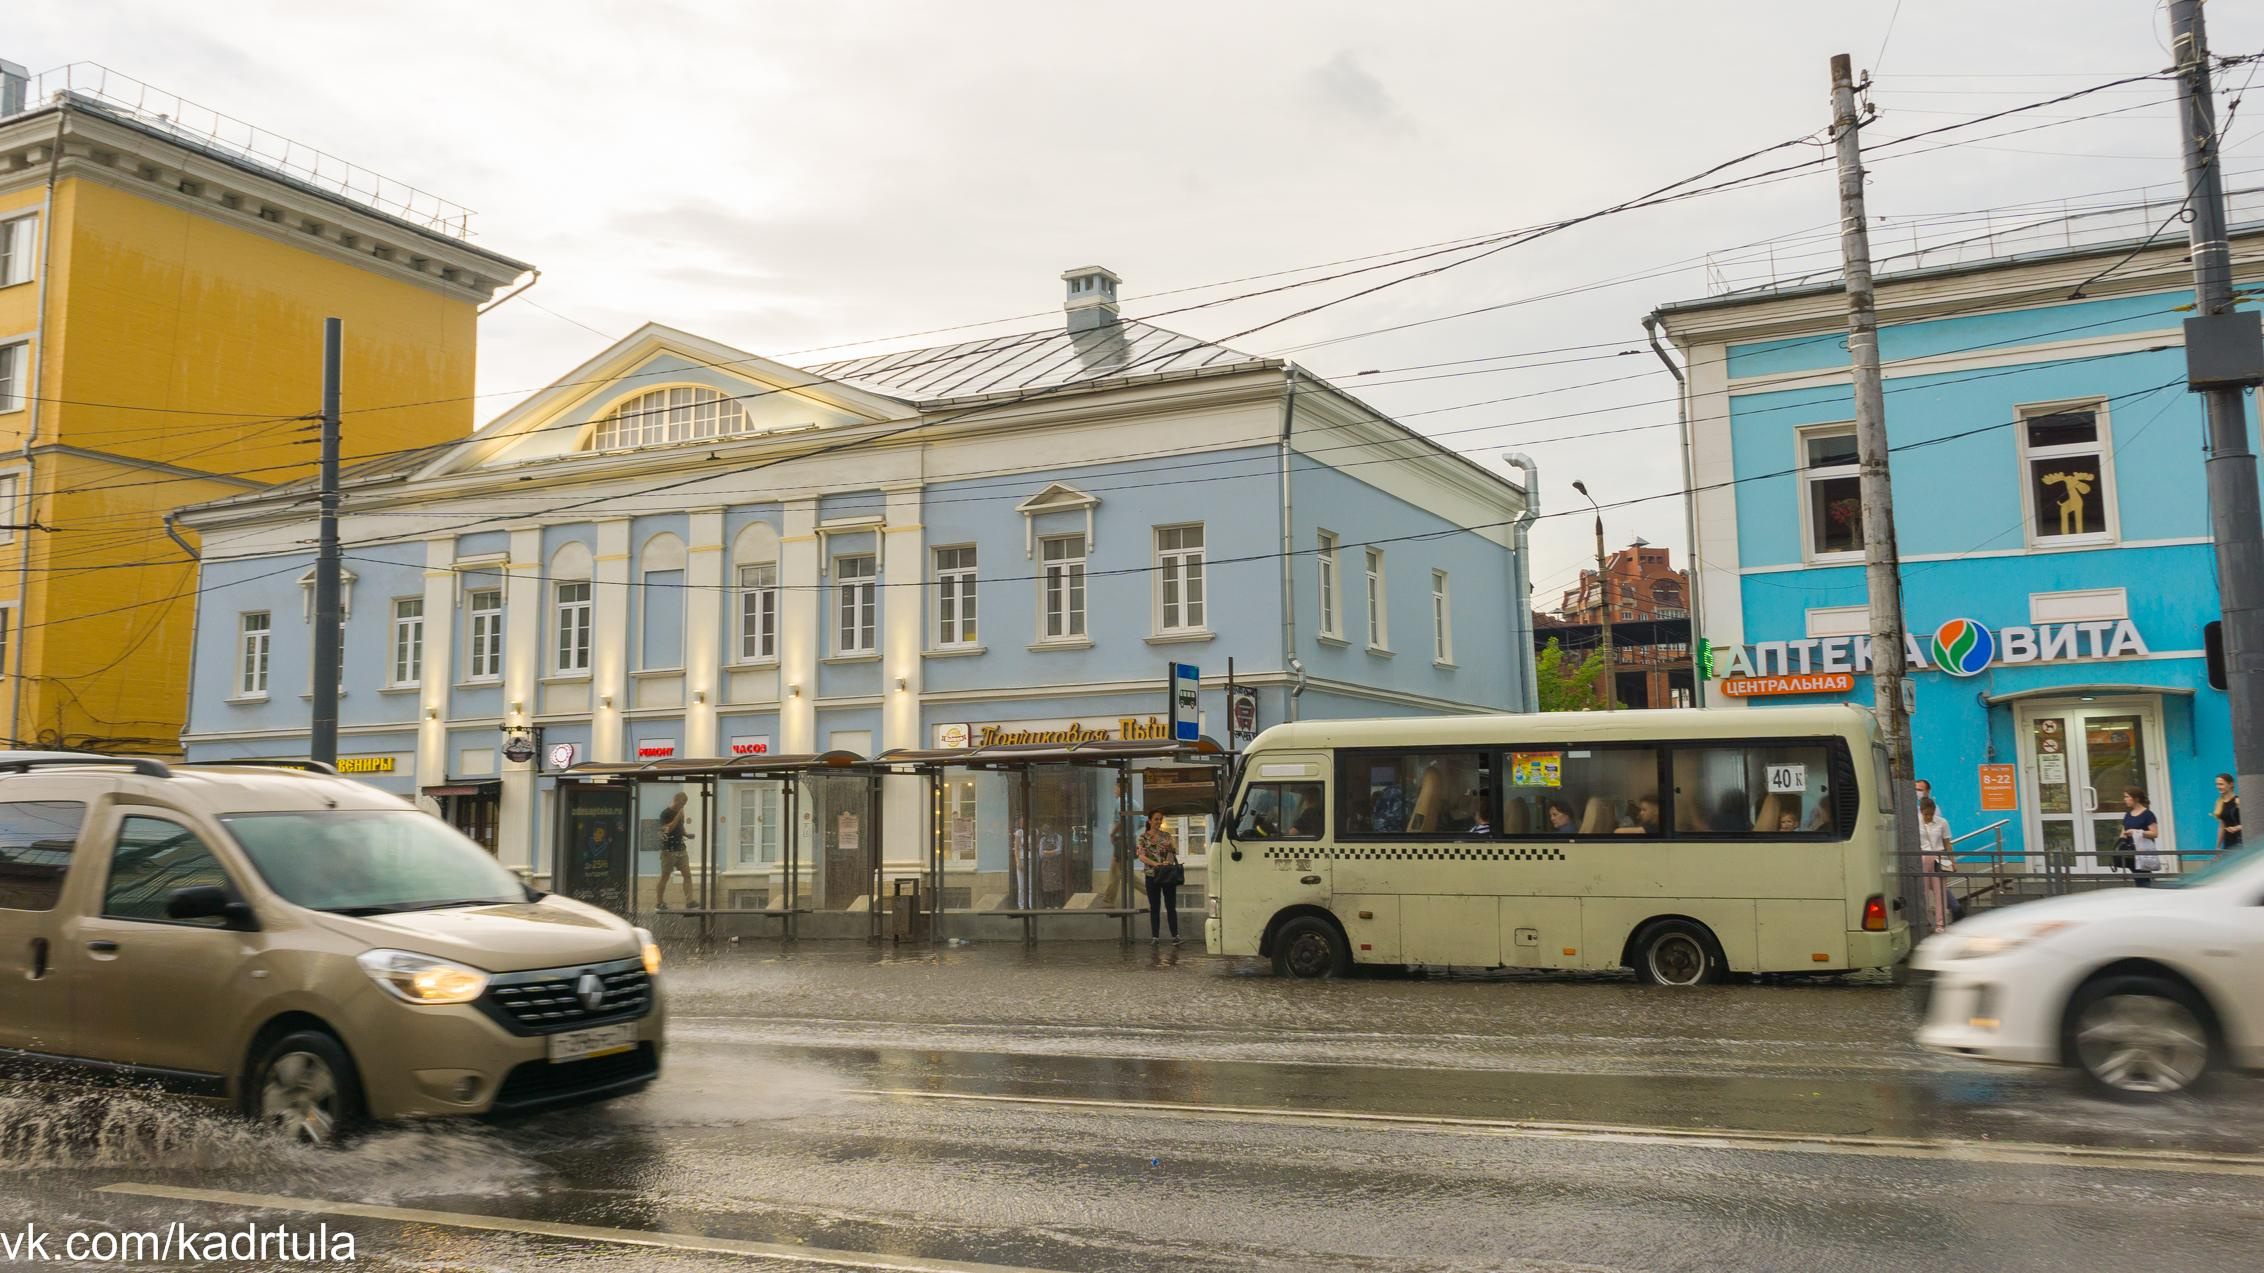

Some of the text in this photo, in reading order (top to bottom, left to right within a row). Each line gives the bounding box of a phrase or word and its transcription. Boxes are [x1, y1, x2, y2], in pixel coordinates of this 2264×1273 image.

[1720, 619, 2150, 679] АПТЕКА ВИТА
[1726, 676, 1848, 696] ЦЕНТРАЛЬНАЯ
[1119, 716, 1168, 741] Пыш
[639, 747, 674, 757] РЕМОНТ
[731, 743, 767, 754] ЧАСОВ
[336, 756, 396, 773] ВЕНИРЫ
[1773, 769, 1791, 788] 40
